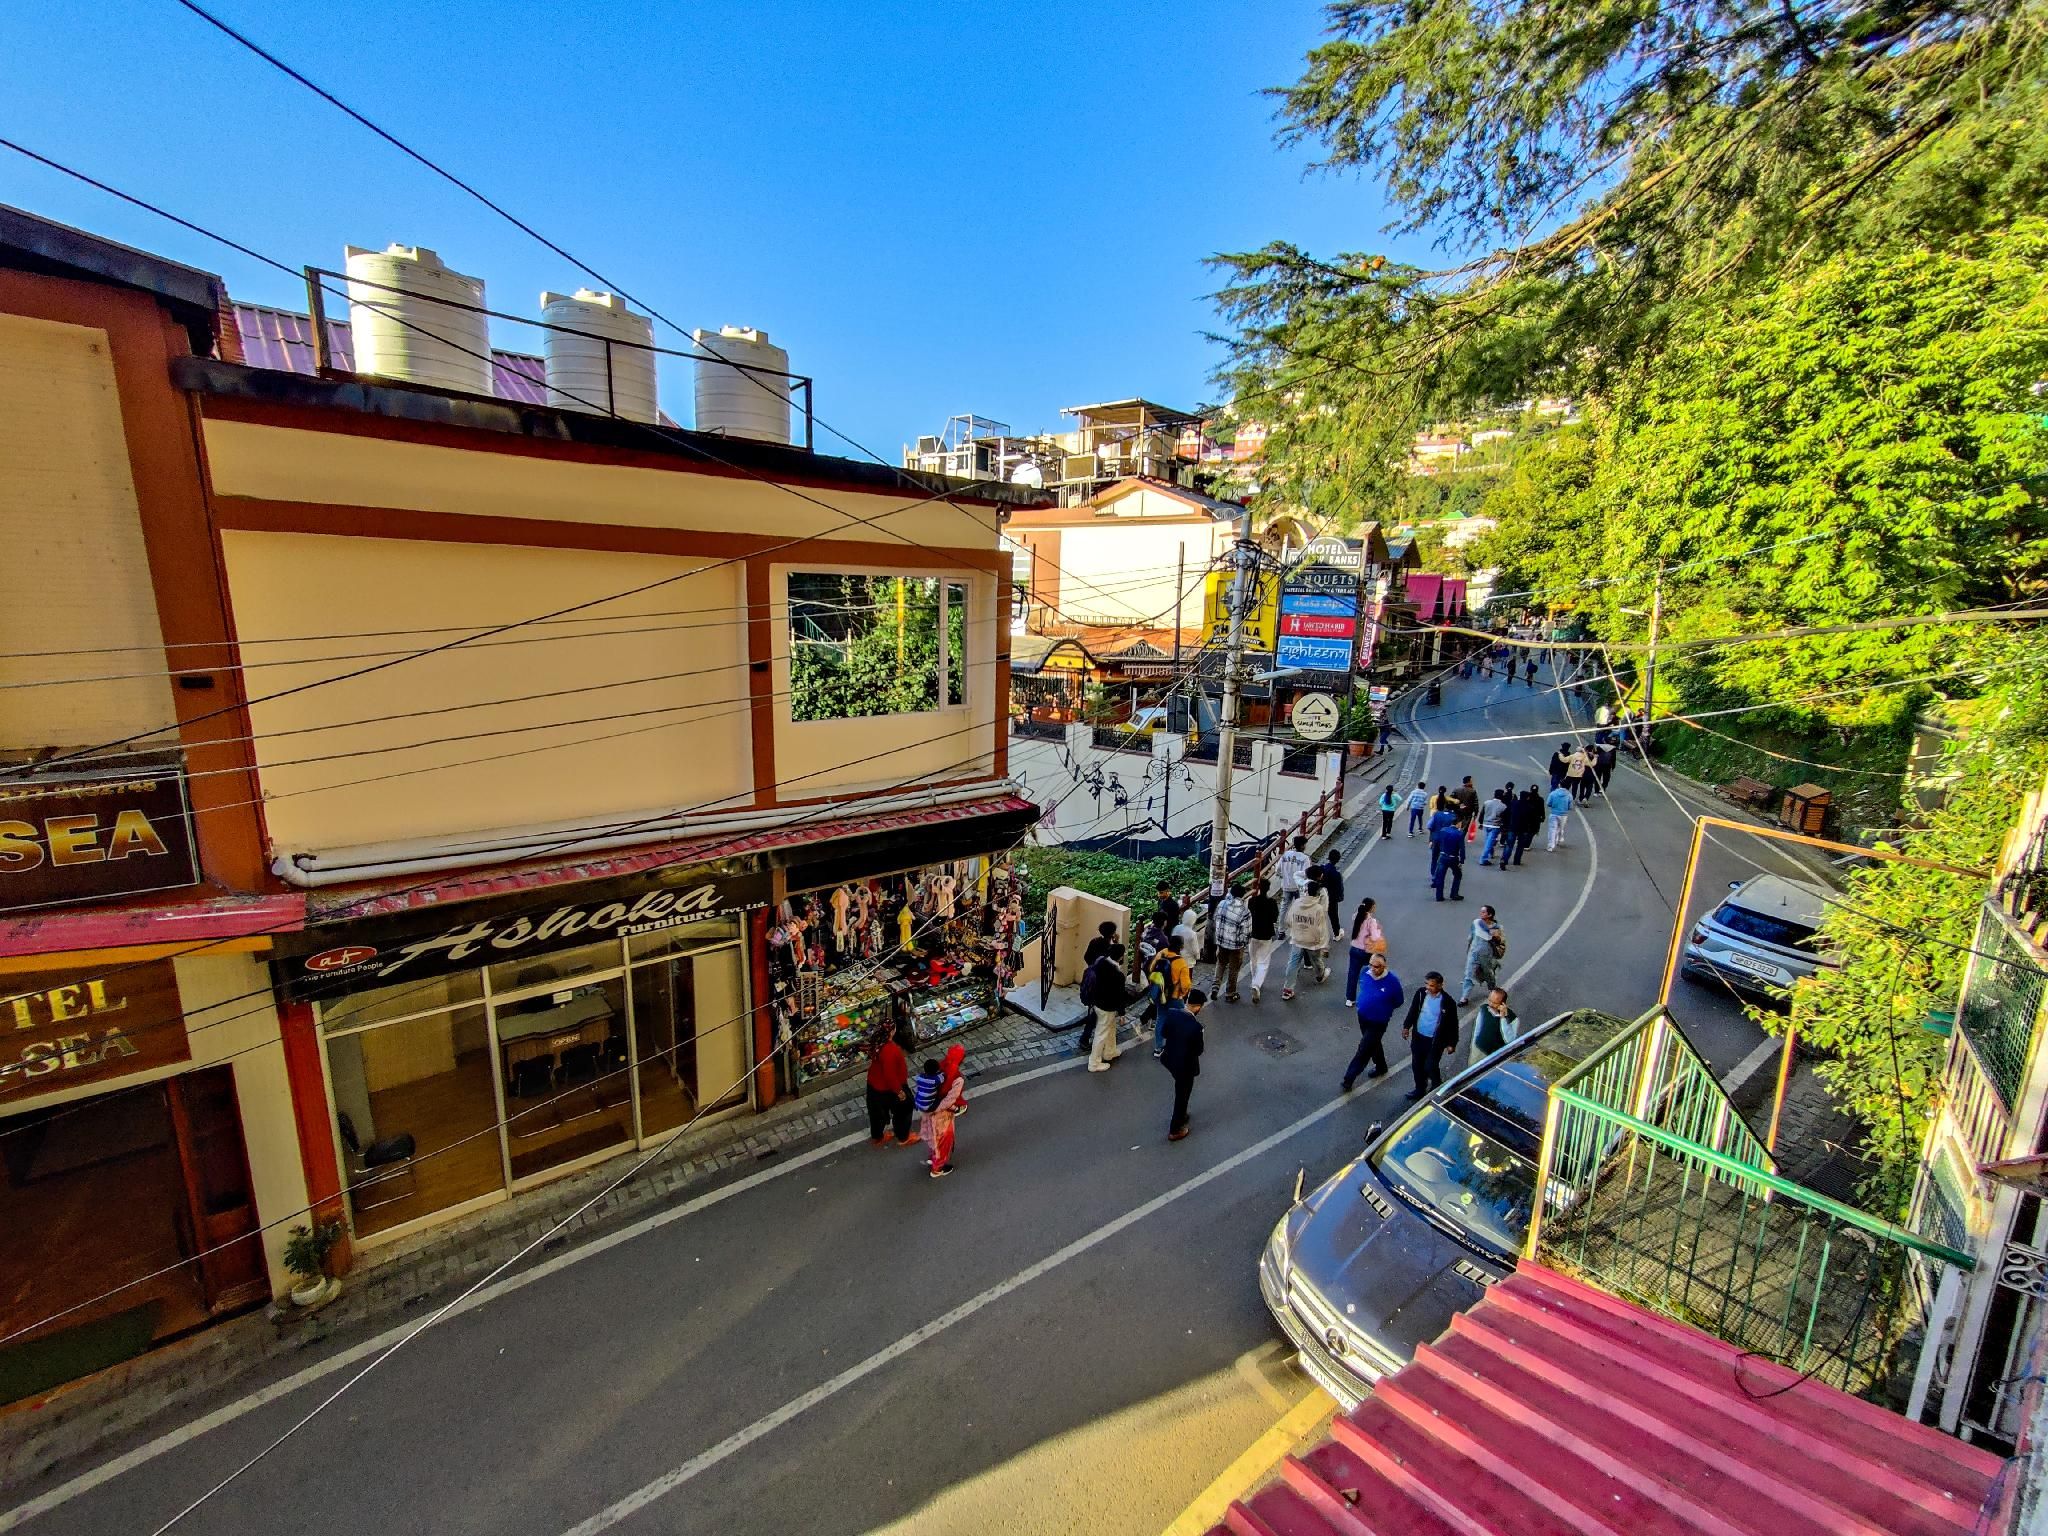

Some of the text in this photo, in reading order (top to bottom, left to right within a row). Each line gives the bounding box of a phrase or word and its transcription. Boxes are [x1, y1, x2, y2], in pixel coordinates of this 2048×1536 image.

[1307, 544, 1343, 555] HOTEL
[1329, 555, 1358, 567] BANKS
[1286, 574, 1354, 586] BNQUETS
[1212, 624, 1261, 637] SHLA
[1361, 630, 1372, 660] BREWERY
[0, 809, 169, 873] SEA
[376, 884, 725, 978] Ashoka
[616, 908, 717, 937] Furniture
[320, 967, 356, 979] Furniture
[357, 961, 383, 972] People
